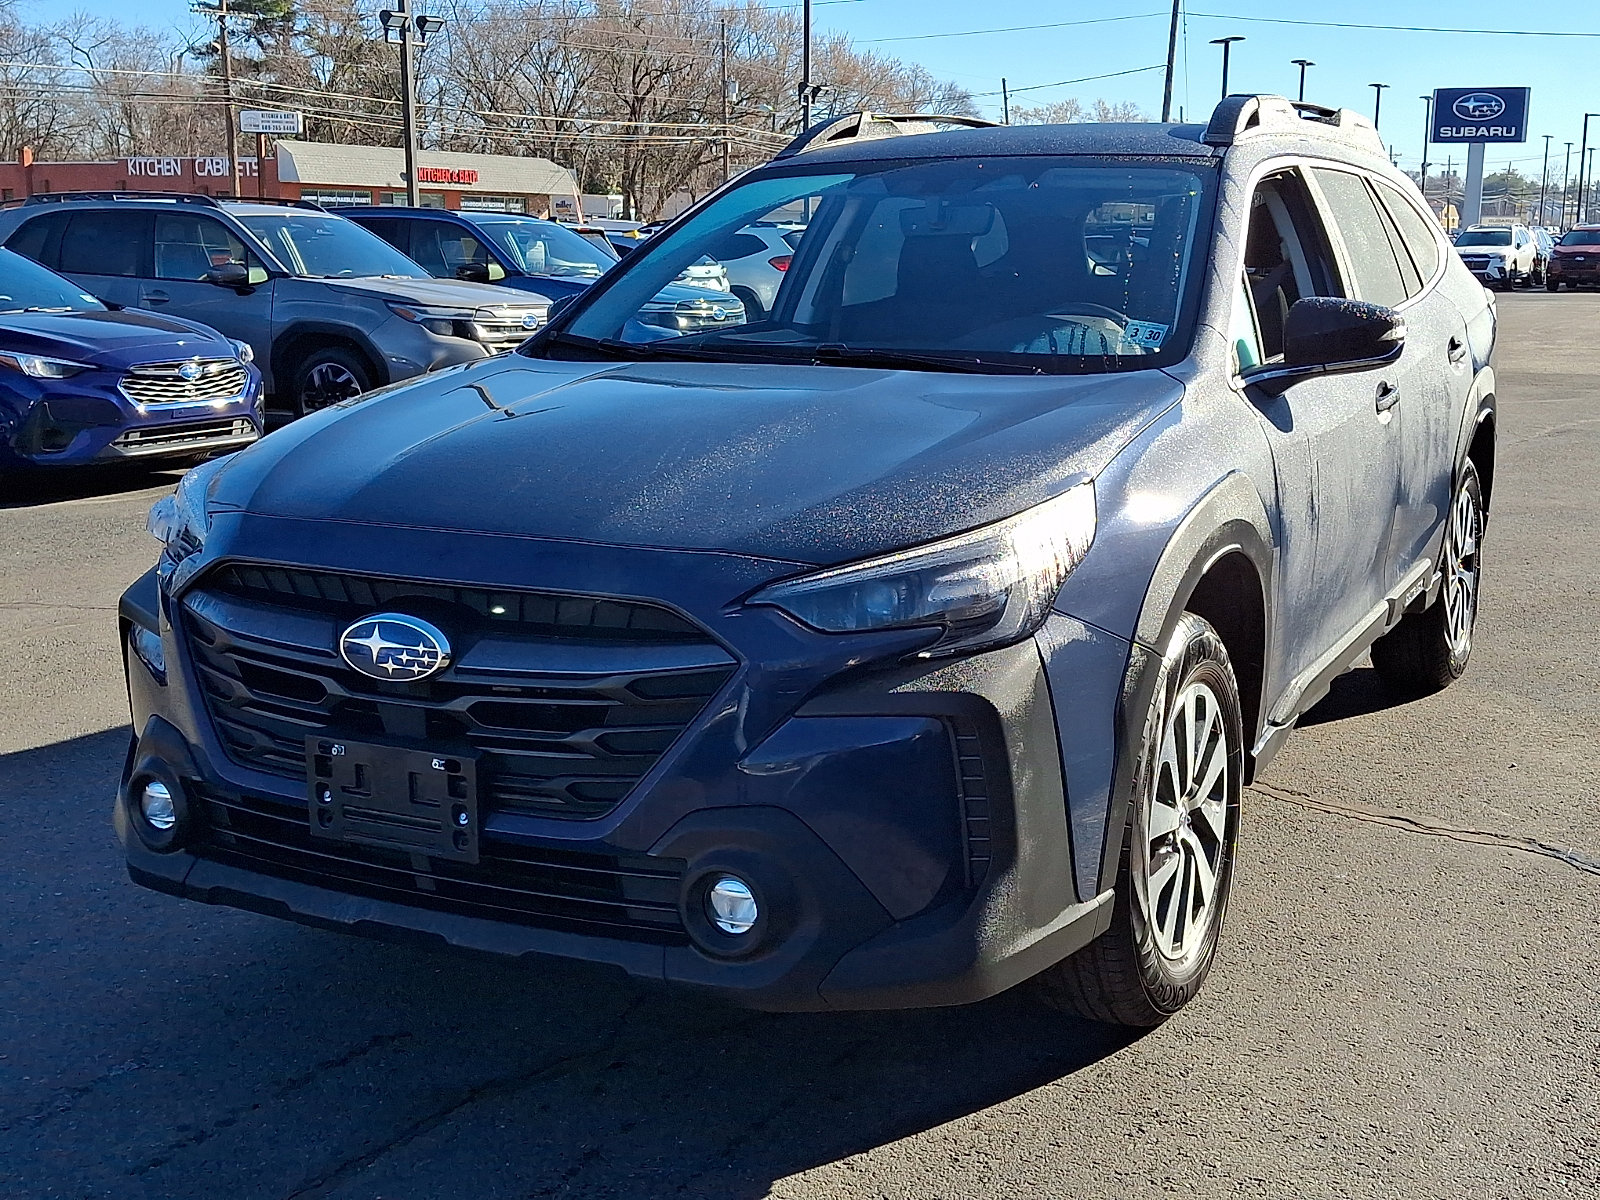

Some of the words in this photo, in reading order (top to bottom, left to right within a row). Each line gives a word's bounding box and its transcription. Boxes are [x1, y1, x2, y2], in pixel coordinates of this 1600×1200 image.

[1440, 126, 1516, 137] SUBARU
[127, 158, 181, 176] KITCHEN
[418, 167, 450, 182] KITCHEN
[452, 170, 459, 182] &
[459, 169, 479, 183] BATH
[1130, 327, 1140, 338] 3
[1145, 329, 1161, 341] 30
